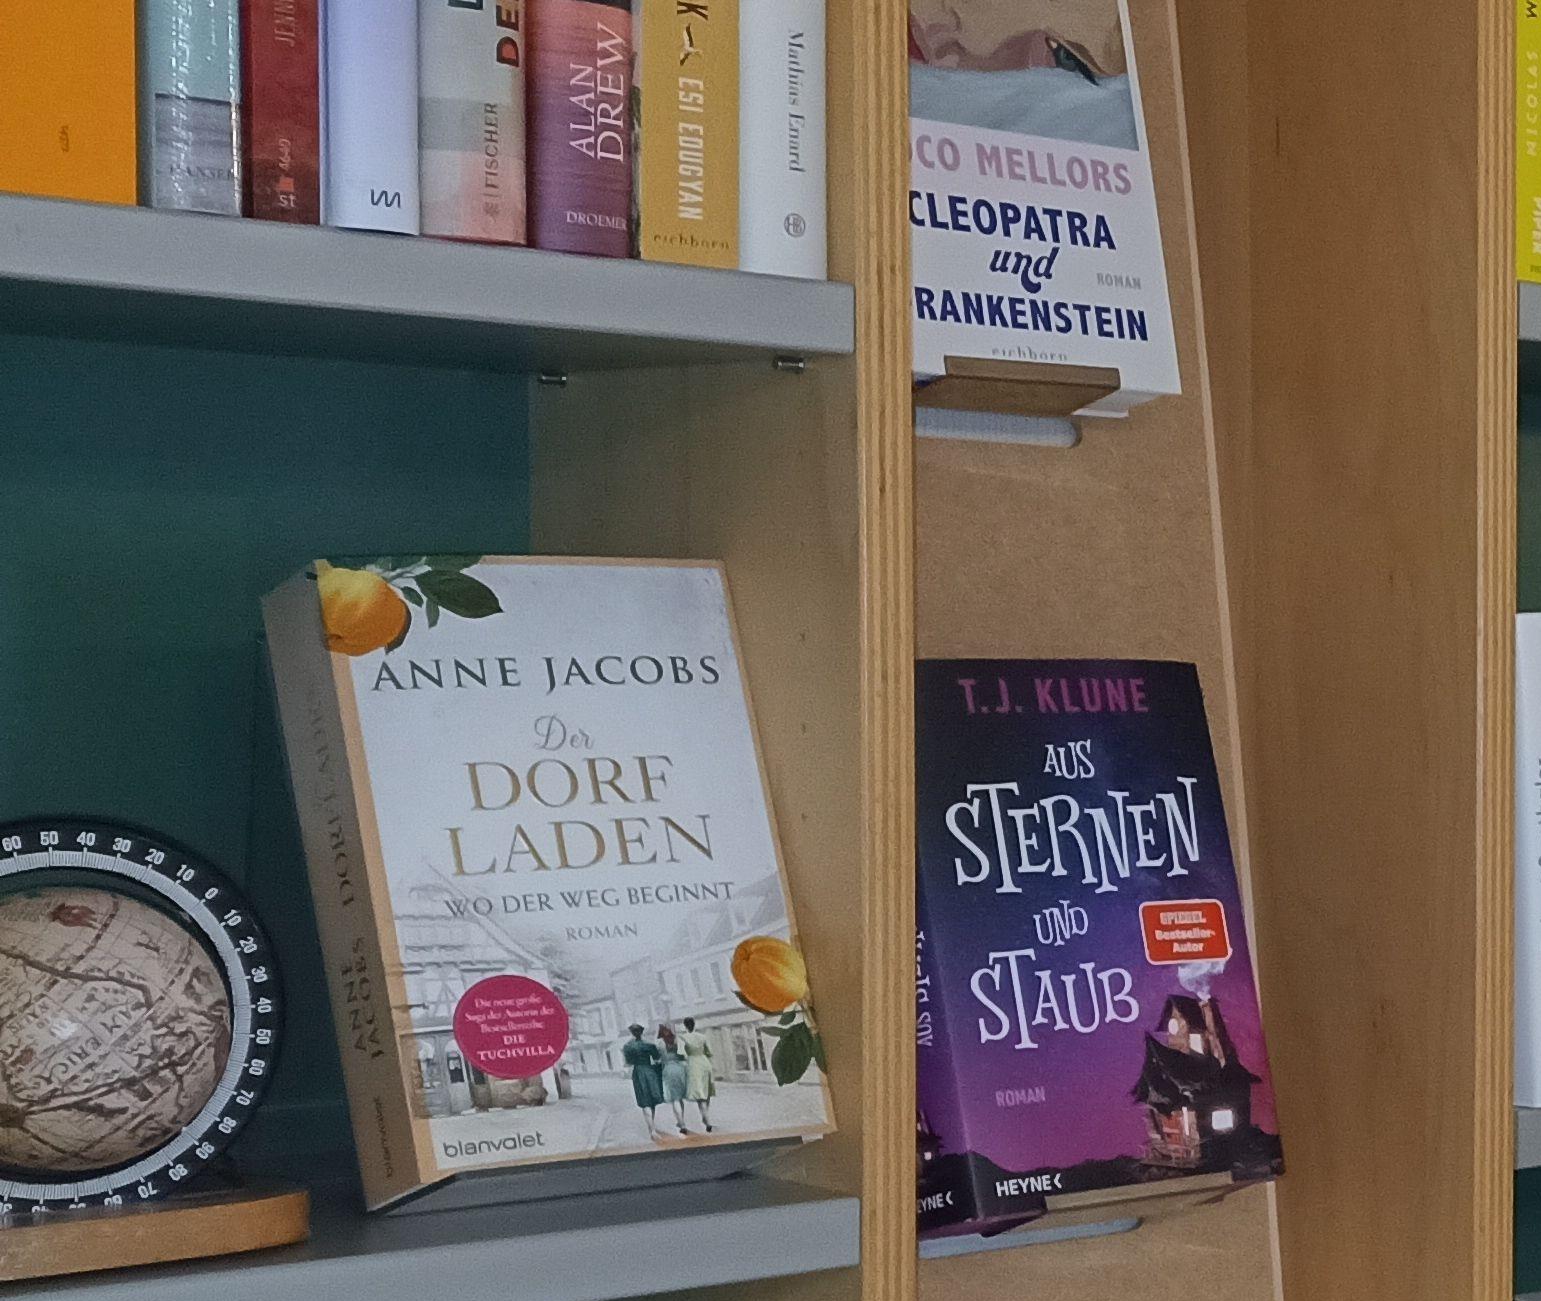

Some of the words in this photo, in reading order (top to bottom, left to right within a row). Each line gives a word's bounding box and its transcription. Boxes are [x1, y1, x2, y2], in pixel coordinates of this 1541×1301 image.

[568, 62, 597, 160] ALAN
[595, 20, 627, 164] DREW
[1525, 48, 1539, 158] NICOLAS
[908, 133, 961, 173] CO
[975, 141, 1133, 196] MELLORS
[566, 210, 628, 232] DROEMER
[908, 190, 1117, 252] CLEOPATRA
[989, 245, 1060, 294] und
[914, 286, 1149, 342] RANKENSTEIN
[372, 656, 524, 694] ANNE
[545, 654, 722, 697] JACOBS
[958, 678, 1024, 716] T.J.
[1034, 677, 1151, 714] KLUNE
[533, 714, 596, 754] Der
[1043, 739, 1096, 780] AUS
[463, 754, 675, 813] DORF
[39, 829, 60, 847] 50
[76, 831, 97, 848] 40
[112, 837, 133, 856] 30
[444, 813, 717, 878] LADEN
[944, 776, 1200, 894] STERNEN
[443, 895, 495, 921] WO
[502, 892, 554, 917] DER
[559, 886, 622, 914] WEG
[625, 880, 736, 909] BEGINNT
[564, 923, 640, 944] ROMAN
[1033, 900, 1089, 946] UND
[970, 949, 1140, 1051] STAUB
[476, 1046, 556, 1061] TUCHVILLA
[502, 1033, 527, 1046] DIE
[443, 1130, 546, 1160] blanvalet
[995, 1175, 1054, 1197] HEYNE
